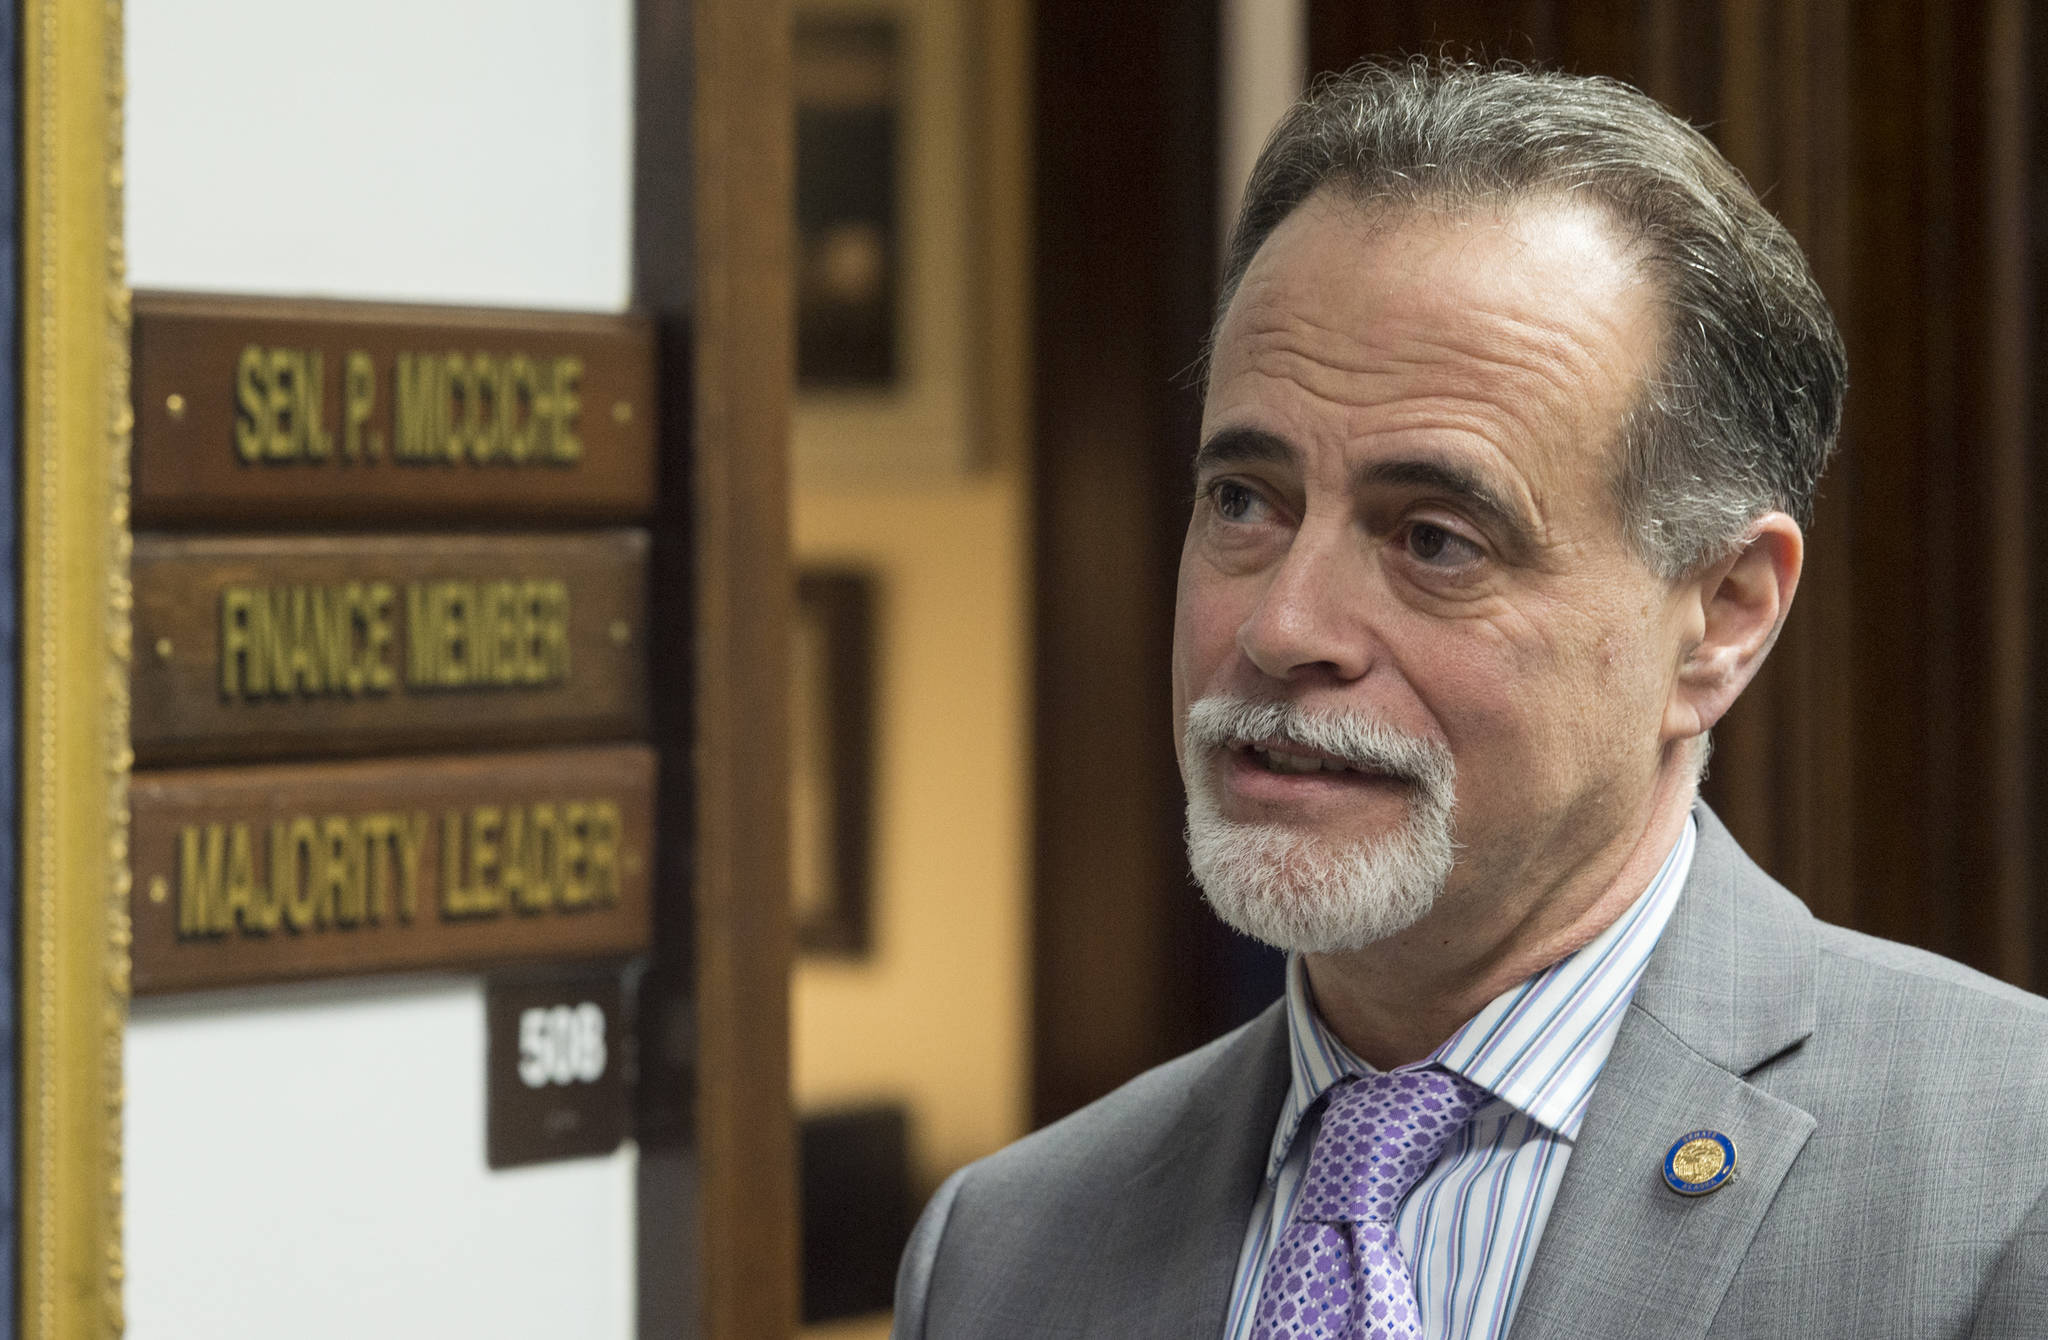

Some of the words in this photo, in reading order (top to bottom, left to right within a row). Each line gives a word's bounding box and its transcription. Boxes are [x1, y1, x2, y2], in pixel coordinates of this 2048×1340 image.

[344, 350, 384, 461] P.
[220, 583, 396, 697] FINANCE
[406, 578, 571, 687] MEMBER
[178, 810, 430, 939] MAJORITY
[440, 803, 622, 915] LEADER
